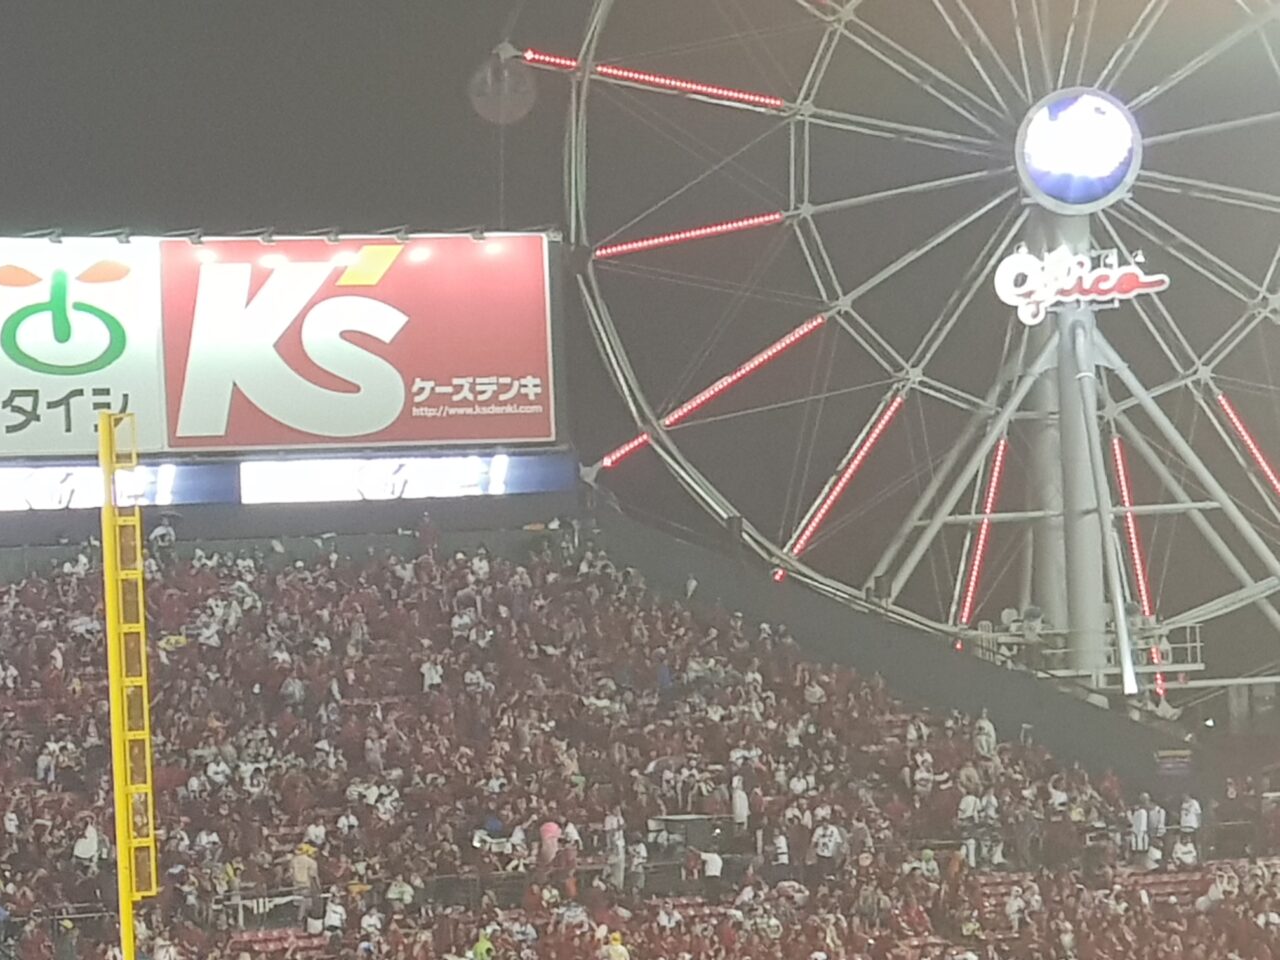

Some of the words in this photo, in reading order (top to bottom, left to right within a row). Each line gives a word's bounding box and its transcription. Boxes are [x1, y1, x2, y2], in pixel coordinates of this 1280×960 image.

[996, 244, 1169, 325] Gico
[411, 375, 542, 402] ケーズデンキ
